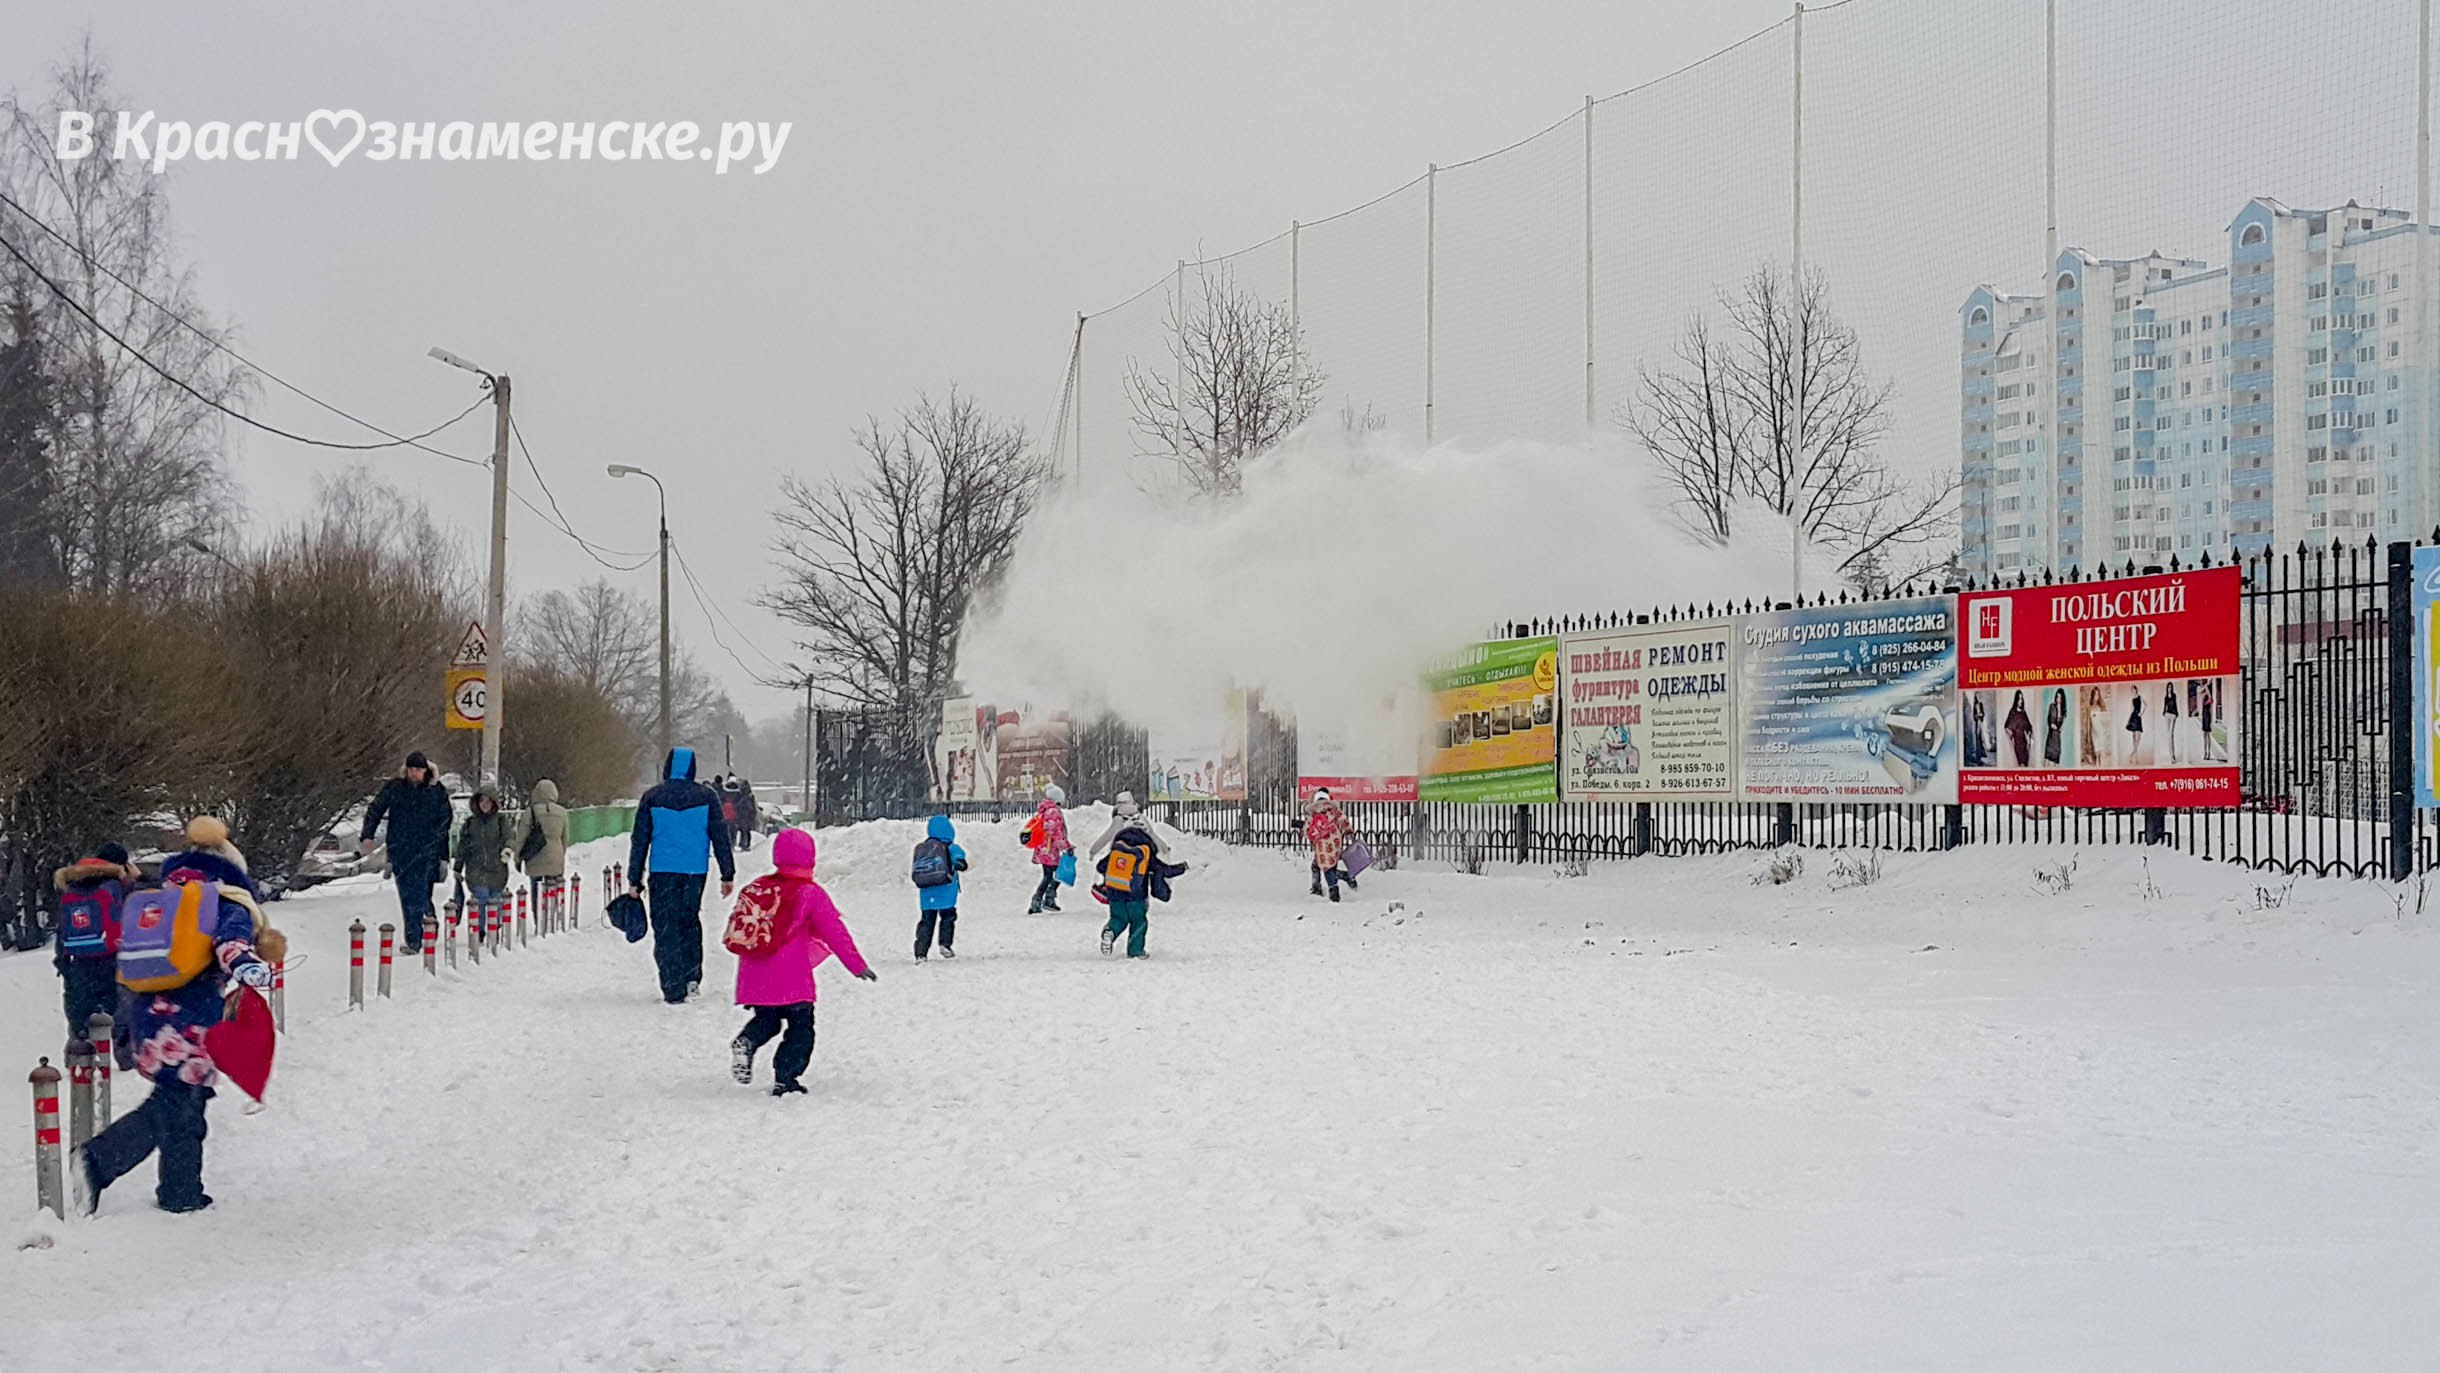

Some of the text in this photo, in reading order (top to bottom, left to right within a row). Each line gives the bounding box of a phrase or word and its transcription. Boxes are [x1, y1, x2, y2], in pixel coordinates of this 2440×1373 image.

[2051, 578, 2187, 624] ПОЛЬСКИЙ
[1744, 612, 1946, 649] Студия сухого аквамассажа
[2076, 622, 2157, 659] ЦЕНТР
[1571, 646, 1641, 674] ШВЕЙНАЯ
[1648, 641, 1727, 667] РЕМОНТ
[1871, 639, 1946, 657] 8 (925) 266-04-84
[1871, 662, 1877, 674] 8
[1879, 661, 1900, 676] (915)
[1968, 656, 2218, 686] Центр модной женской одежды из Польши
[461, 691, 486, 708] 40
[1648, 673, 1727, 704] ОДЕЖДЫ
[1570, 704, 1641, 727] ГАЛАНТЕРЕЯ
[1772, 741, 1789, 752] БЕЗ
[1745, 786, 1782, 795] ПРИХОДИТЕ
[1791, 786, 1829, 795] УБЕДИТЕСЬ
[1844, 786, 1860, 795] МИН
[1861, 786, 1904, 795] БЕСПЛАТНО
